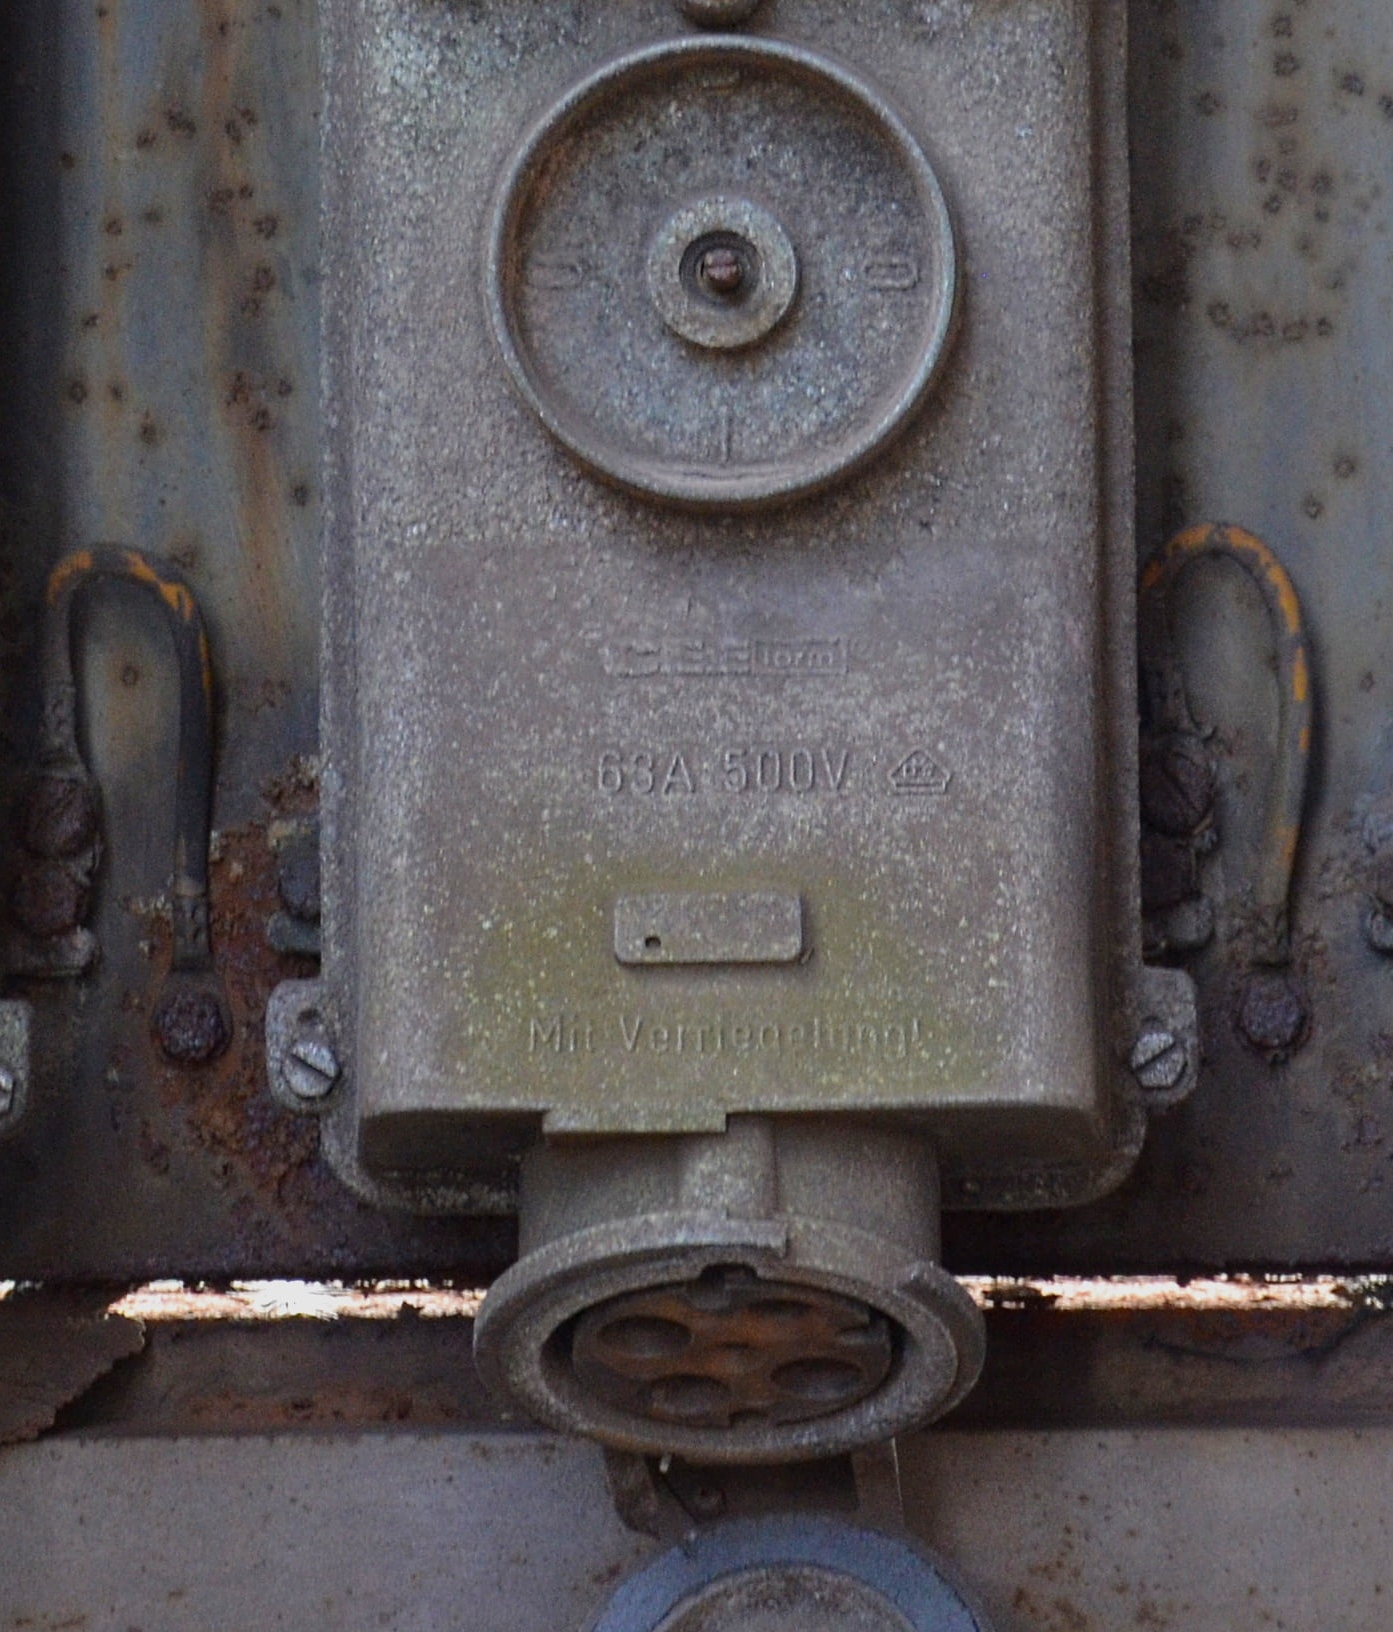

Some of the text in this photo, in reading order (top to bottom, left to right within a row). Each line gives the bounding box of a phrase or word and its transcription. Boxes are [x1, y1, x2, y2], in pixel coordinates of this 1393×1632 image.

[596, 749, 699, 796] 63A
[723, 748, 851, 794] 500V
[527, 1013, 594, 1056] Mit
